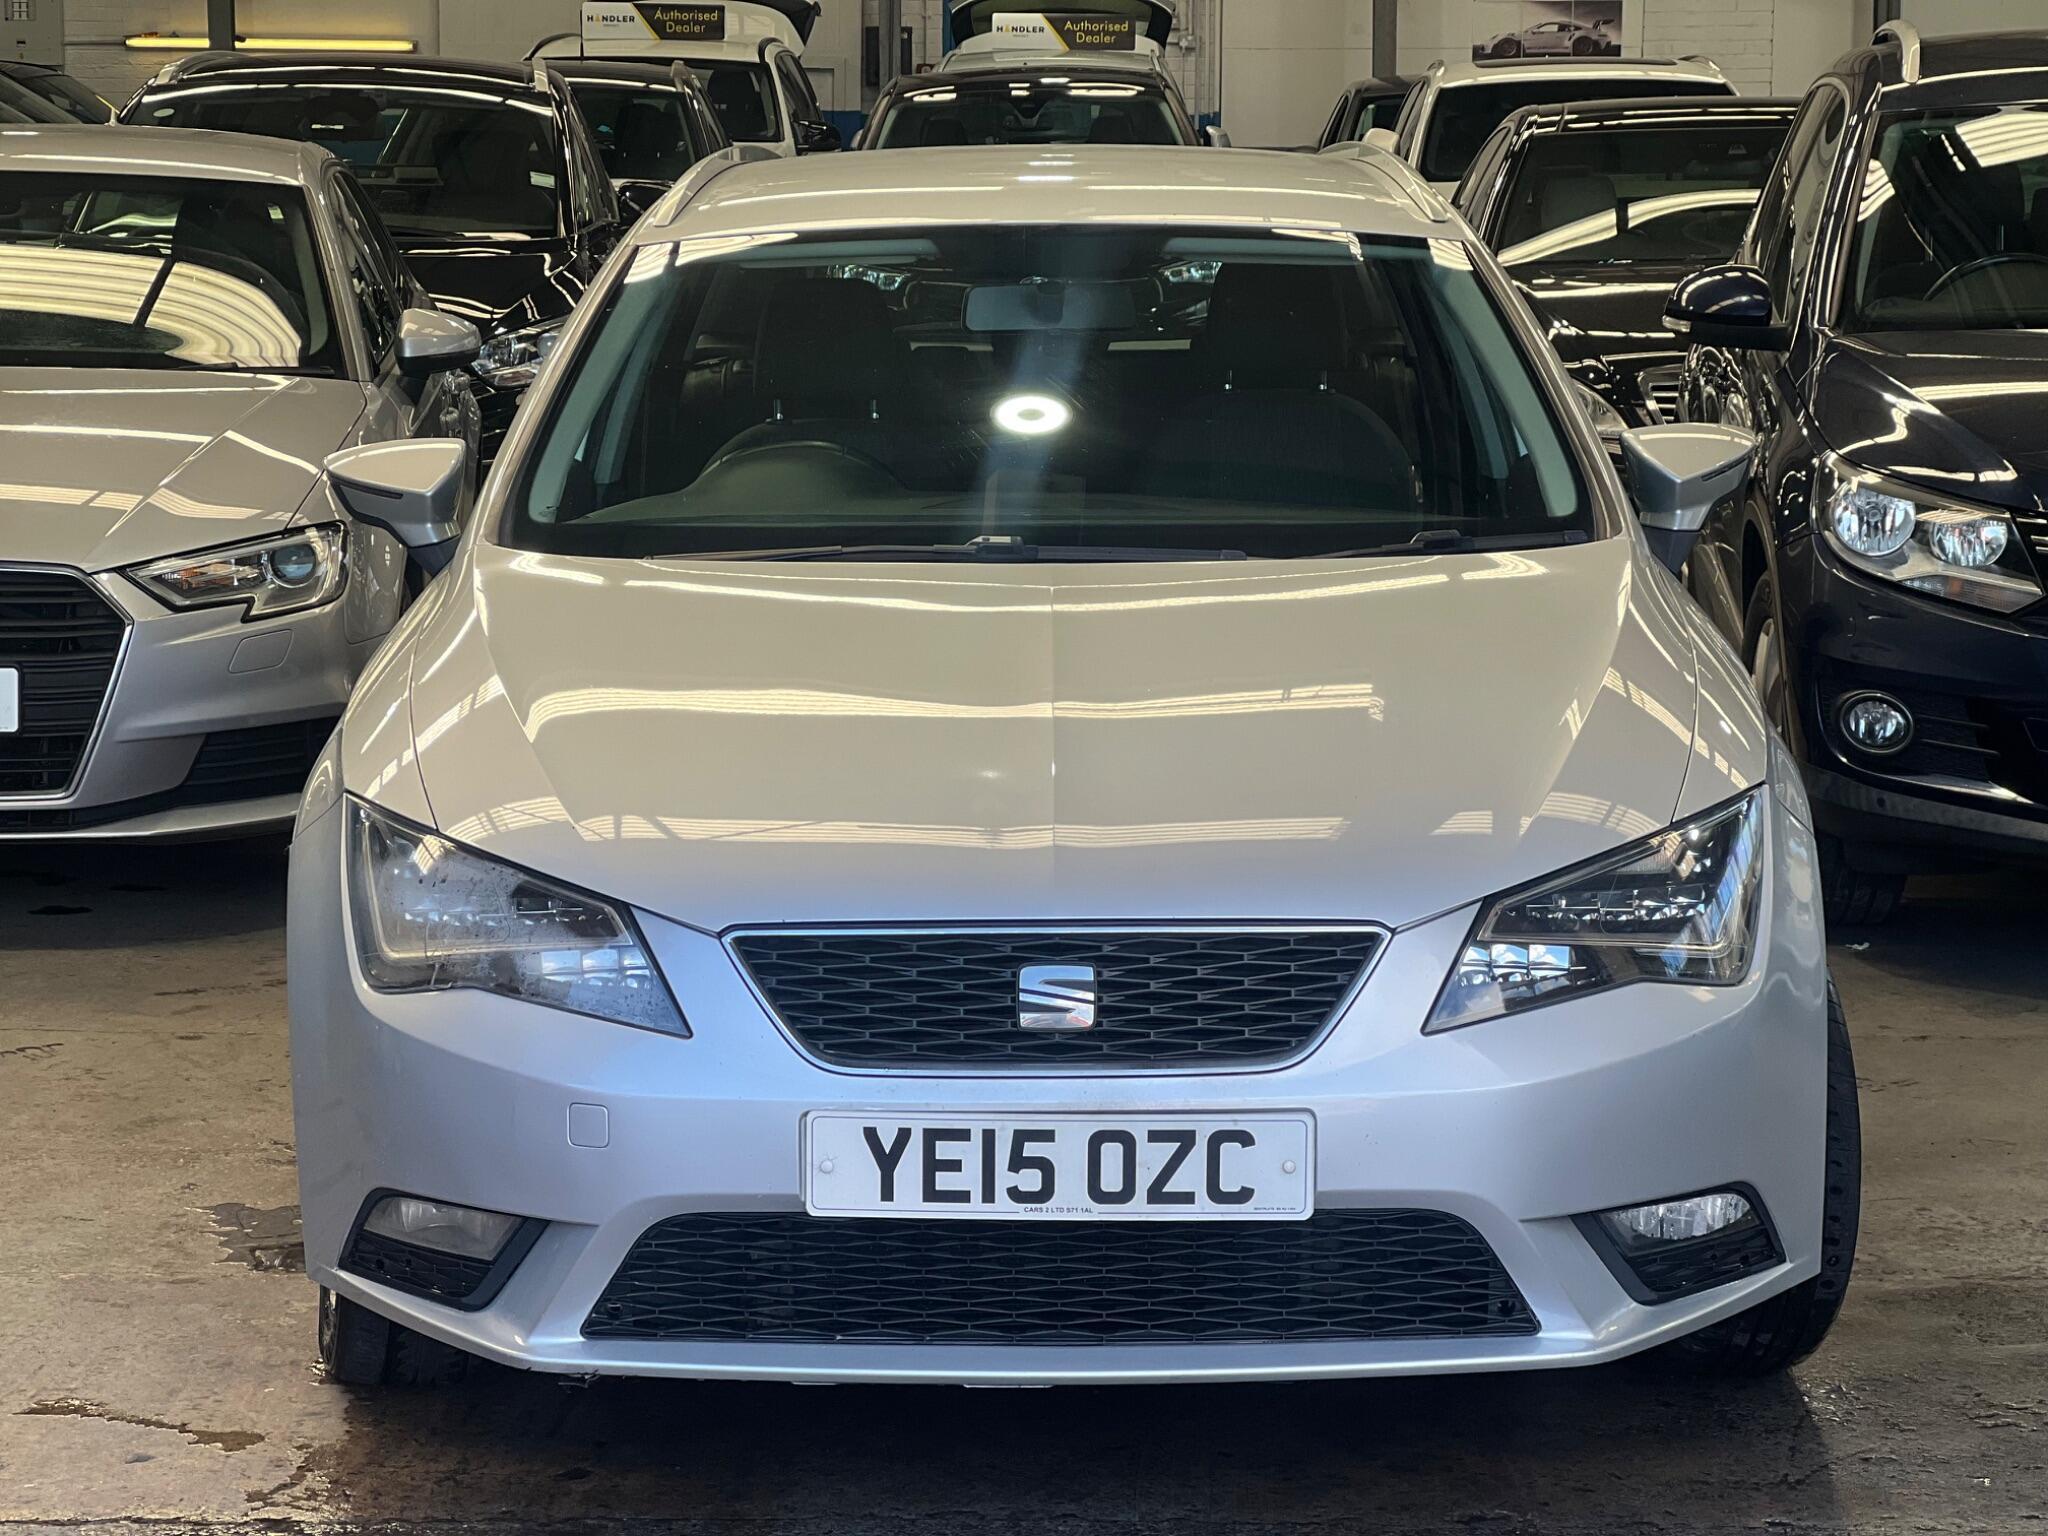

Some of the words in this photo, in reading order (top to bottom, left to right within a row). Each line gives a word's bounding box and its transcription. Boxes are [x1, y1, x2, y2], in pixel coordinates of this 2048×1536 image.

[654, 8, 718, 21] Authorised
[666, 21, 706, 33] Dealer
[1064, 20, 1129, 32] Authorised
[1076, 32, 1116, 43] Dealer
[862, 1126, 1056, 1205] YE15
[1087, 1129, 1256, 1205] OZC
